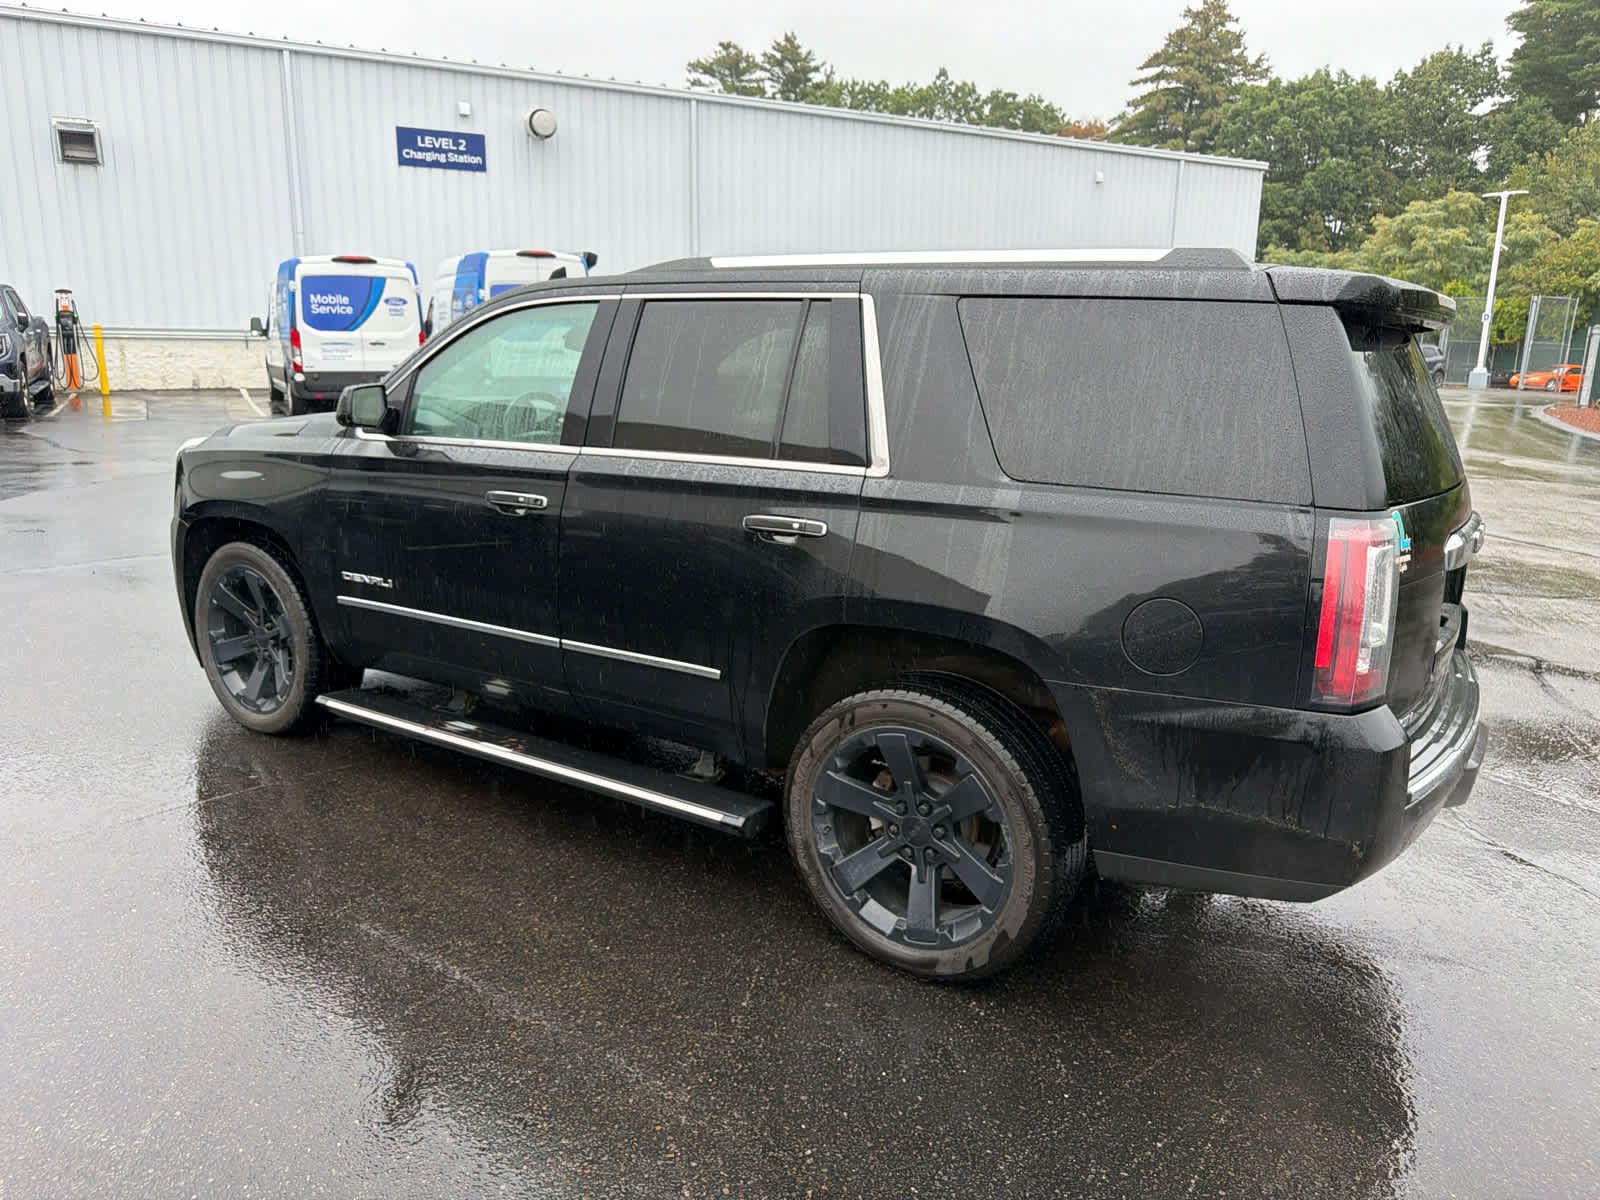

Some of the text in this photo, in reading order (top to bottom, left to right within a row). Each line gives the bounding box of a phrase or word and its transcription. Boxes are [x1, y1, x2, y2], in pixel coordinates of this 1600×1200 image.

[416, 135, 467, 151] LEVEL 2
[402, 148, 482, 165] Charging Station
[310, 293, 350, 305] Mobile
[311, 304, 353, 314] Service
